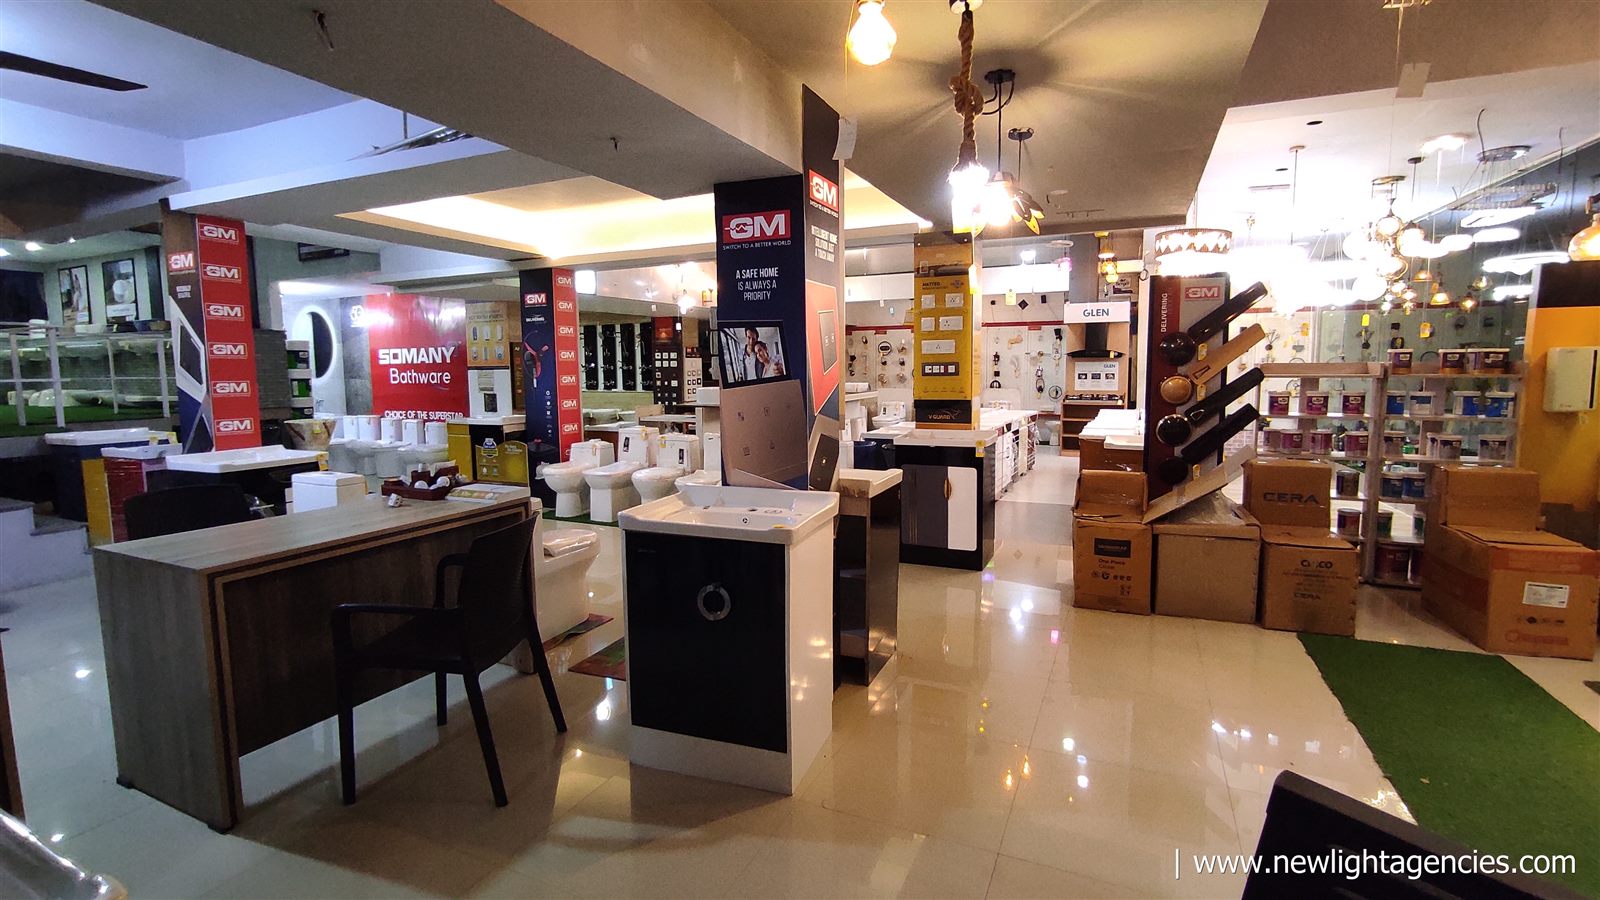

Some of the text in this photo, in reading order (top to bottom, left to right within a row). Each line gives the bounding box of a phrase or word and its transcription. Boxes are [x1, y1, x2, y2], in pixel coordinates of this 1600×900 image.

[812, 175, 837, 208] GM
[729, 213, 786, 239] GM
[203, 225, 236, 240] GM
[722, 243, 742, 251] SWITCH
[772, 239, 792, 247] WORLD
[171, 253, 194, 269] GM
[206, 265, 239, 279] GM
[735, 267, 779, 280] A SAFE HOME
[557, 276, 573, 286] GM
[737, 279, 777, 291] IS ALWAYS A
[743, 290, 771, 301] PRIORITY
[1188, 287, 1219, 298] GM
[525, 293, 547, 305] GM
[208, 305, 242, 317] GM
[557, 301, 574, 311] GM
[1083, 308, 1110, 317] GLEN
[1160, 292, 1168, 333] DELIVERING
[559, 326, 574, 335] GM
[212, 344, 245, 355] GM
[378, 346, 455, 365] SOMANY
[560, 351, 575, 360] GM
[389, 367, 452, 385] Bathware
[561, 376, 576, 384] GM
[215, 382, 248, 394] GM
[384, 410, 407, 420] CHOICE
[407, 410, 416, 418] OF
[417, 410, 428, 420] THE
[219, 419, 252, 432] GM
[1263, 492, 1320, 505] CERA
